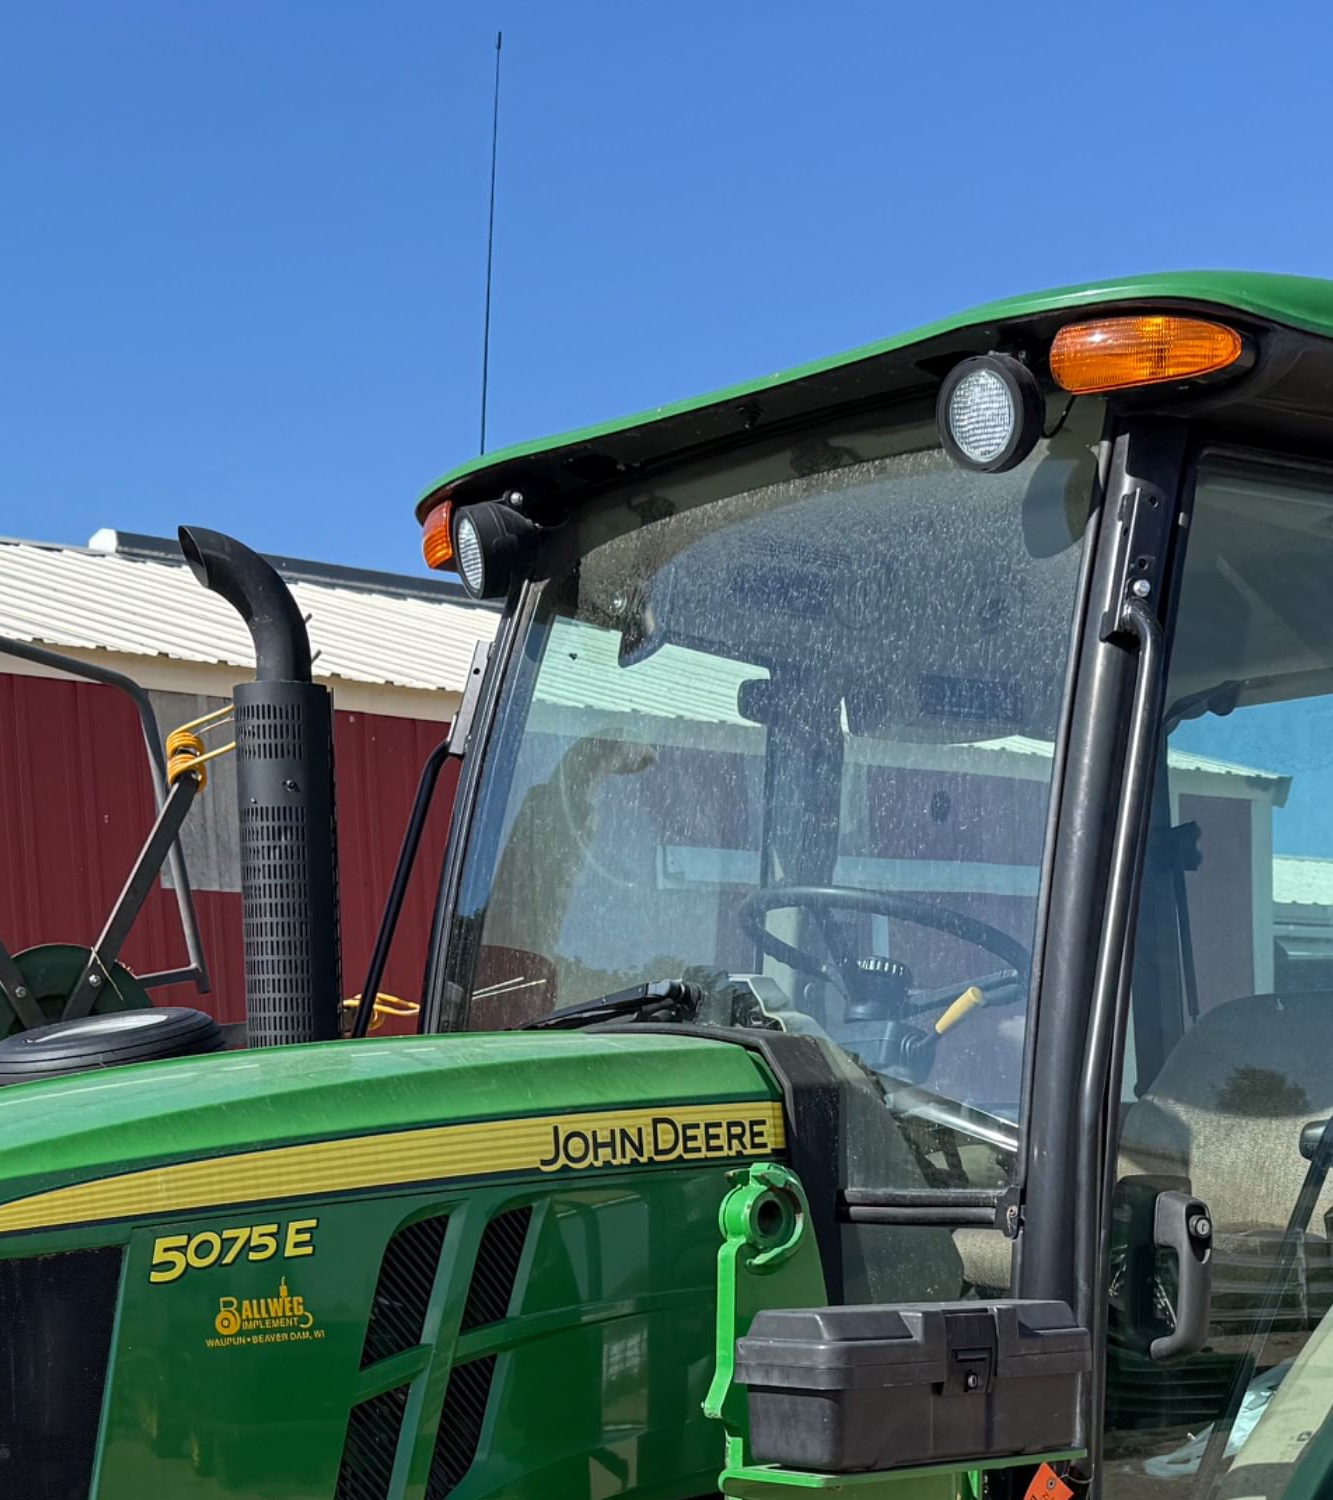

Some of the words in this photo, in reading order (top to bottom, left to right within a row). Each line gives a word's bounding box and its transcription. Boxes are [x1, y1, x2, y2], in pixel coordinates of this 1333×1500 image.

[540, 1124, 645, 1167] JOHN
[651, 1117, 768, 1157] DEERE
[215, 1296, 304, 1335] BALLWEG
[242, 1317, 299, 1331] IMPLEMENT
[205, 1336, 247, 1348] WAUPUN
[251, 1332, 289, 1345] BEAVER
[289, 1330, 313, 1341] DAM,
[313, 1328, 326, 1339] WI
